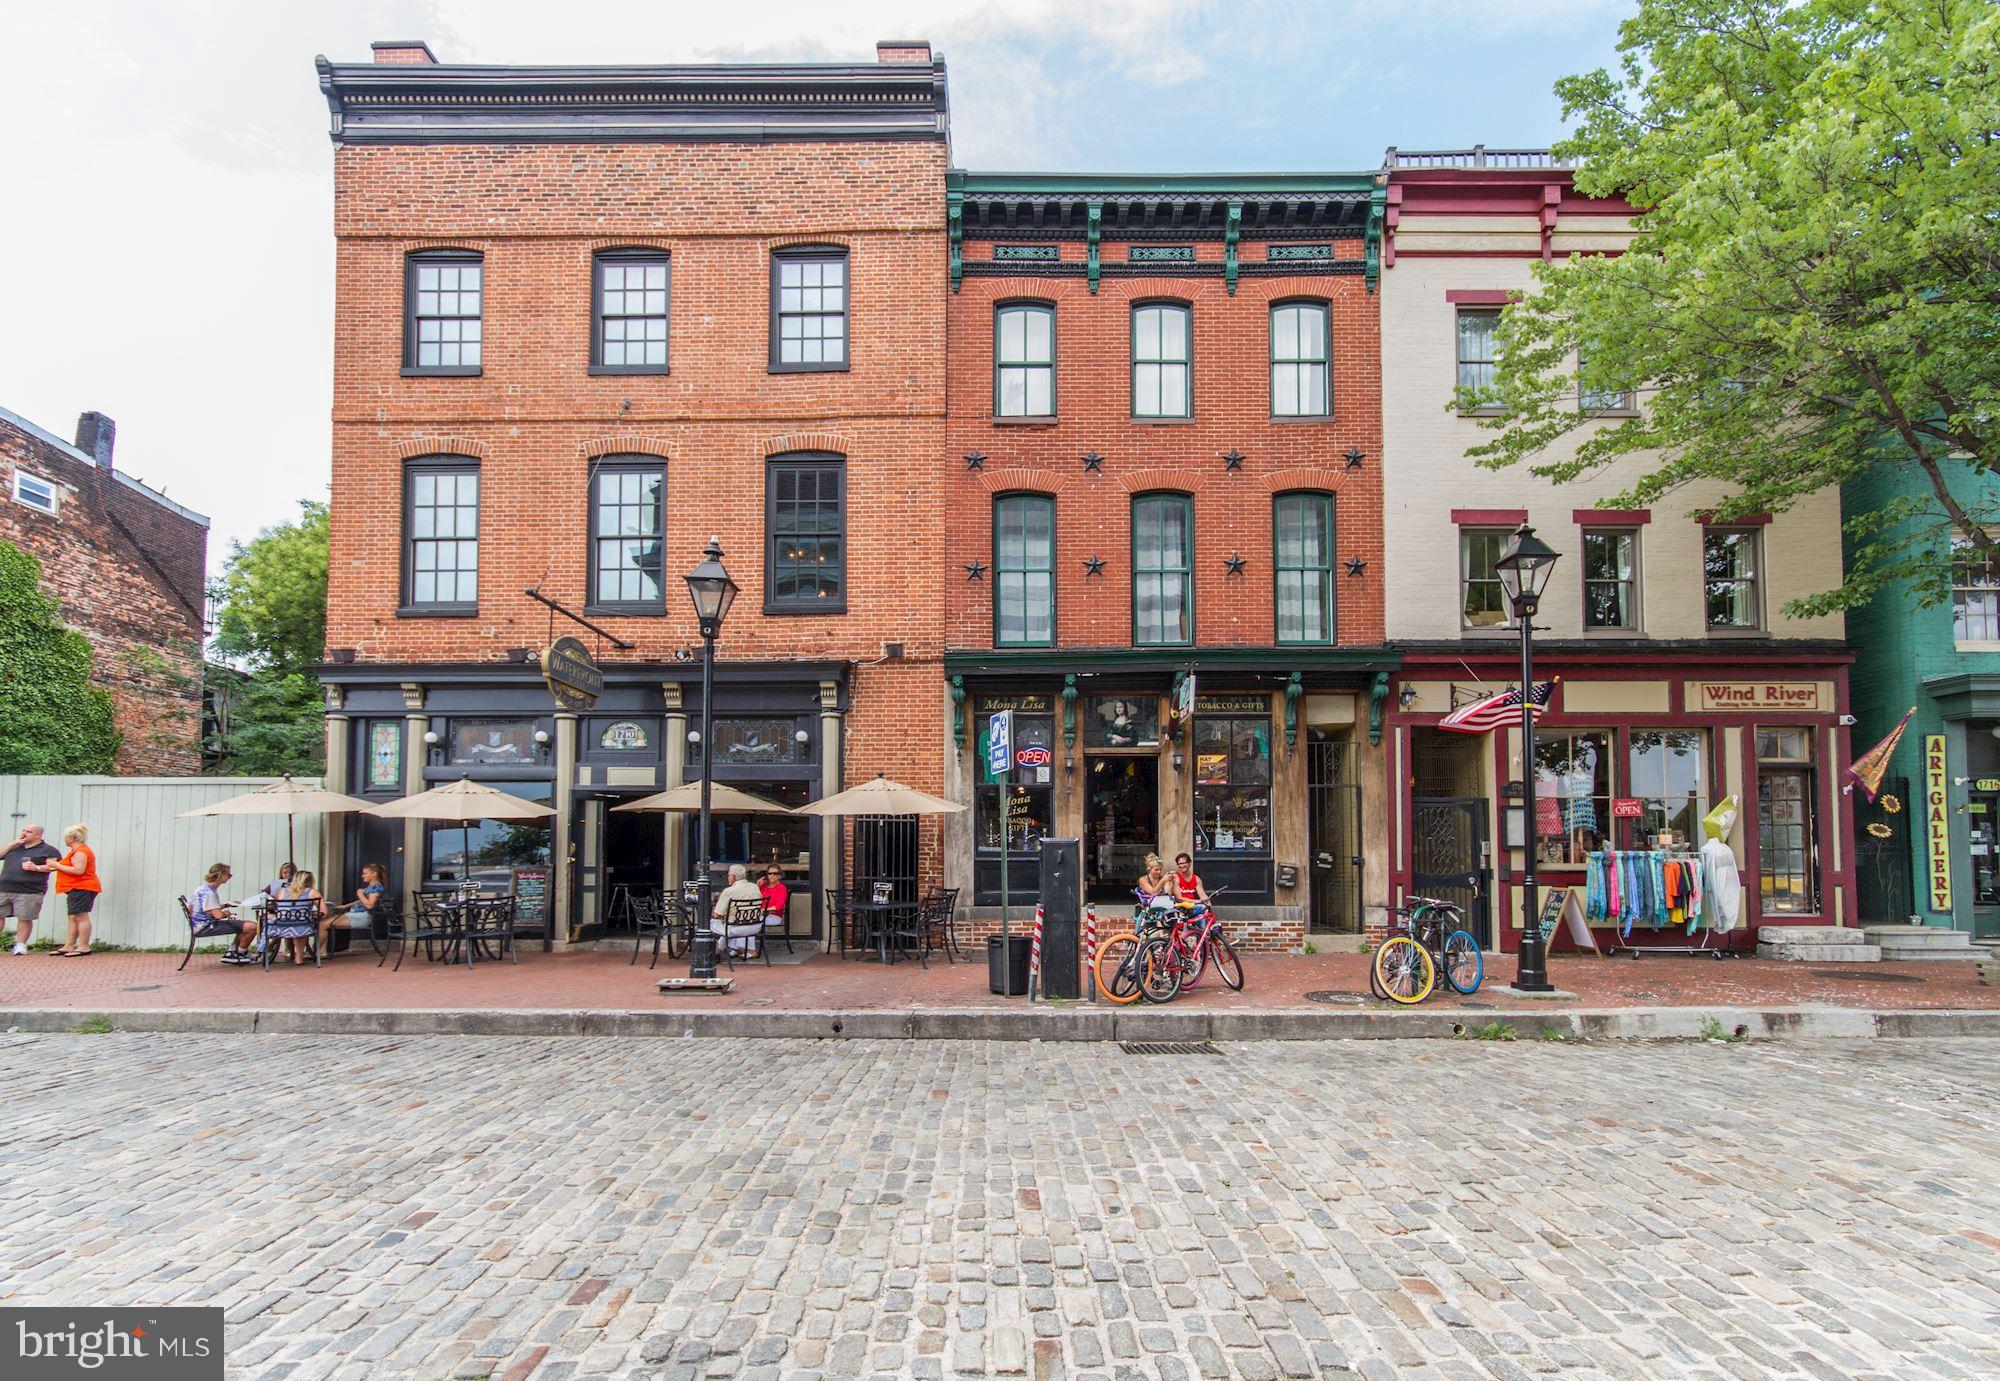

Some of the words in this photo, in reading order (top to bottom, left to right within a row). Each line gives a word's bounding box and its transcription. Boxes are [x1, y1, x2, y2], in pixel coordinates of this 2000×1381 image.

[552, 653, 601, 689] WATERFRONT
[1706, 686, 1754, 701] Wind
[1766, 685, 1815, 701] River
[984, 700, 1017, 710] Mona
[1021, 700, 1045, 709] Lisa
[615, 730, 635, 739] 1710
[994, 748, 1004, 760] PAY
[1017, 751, 1051, 763] OPEN
[992, 759, 1006, 770] HERE
[1615, 805, 1640, 815] OPEN
